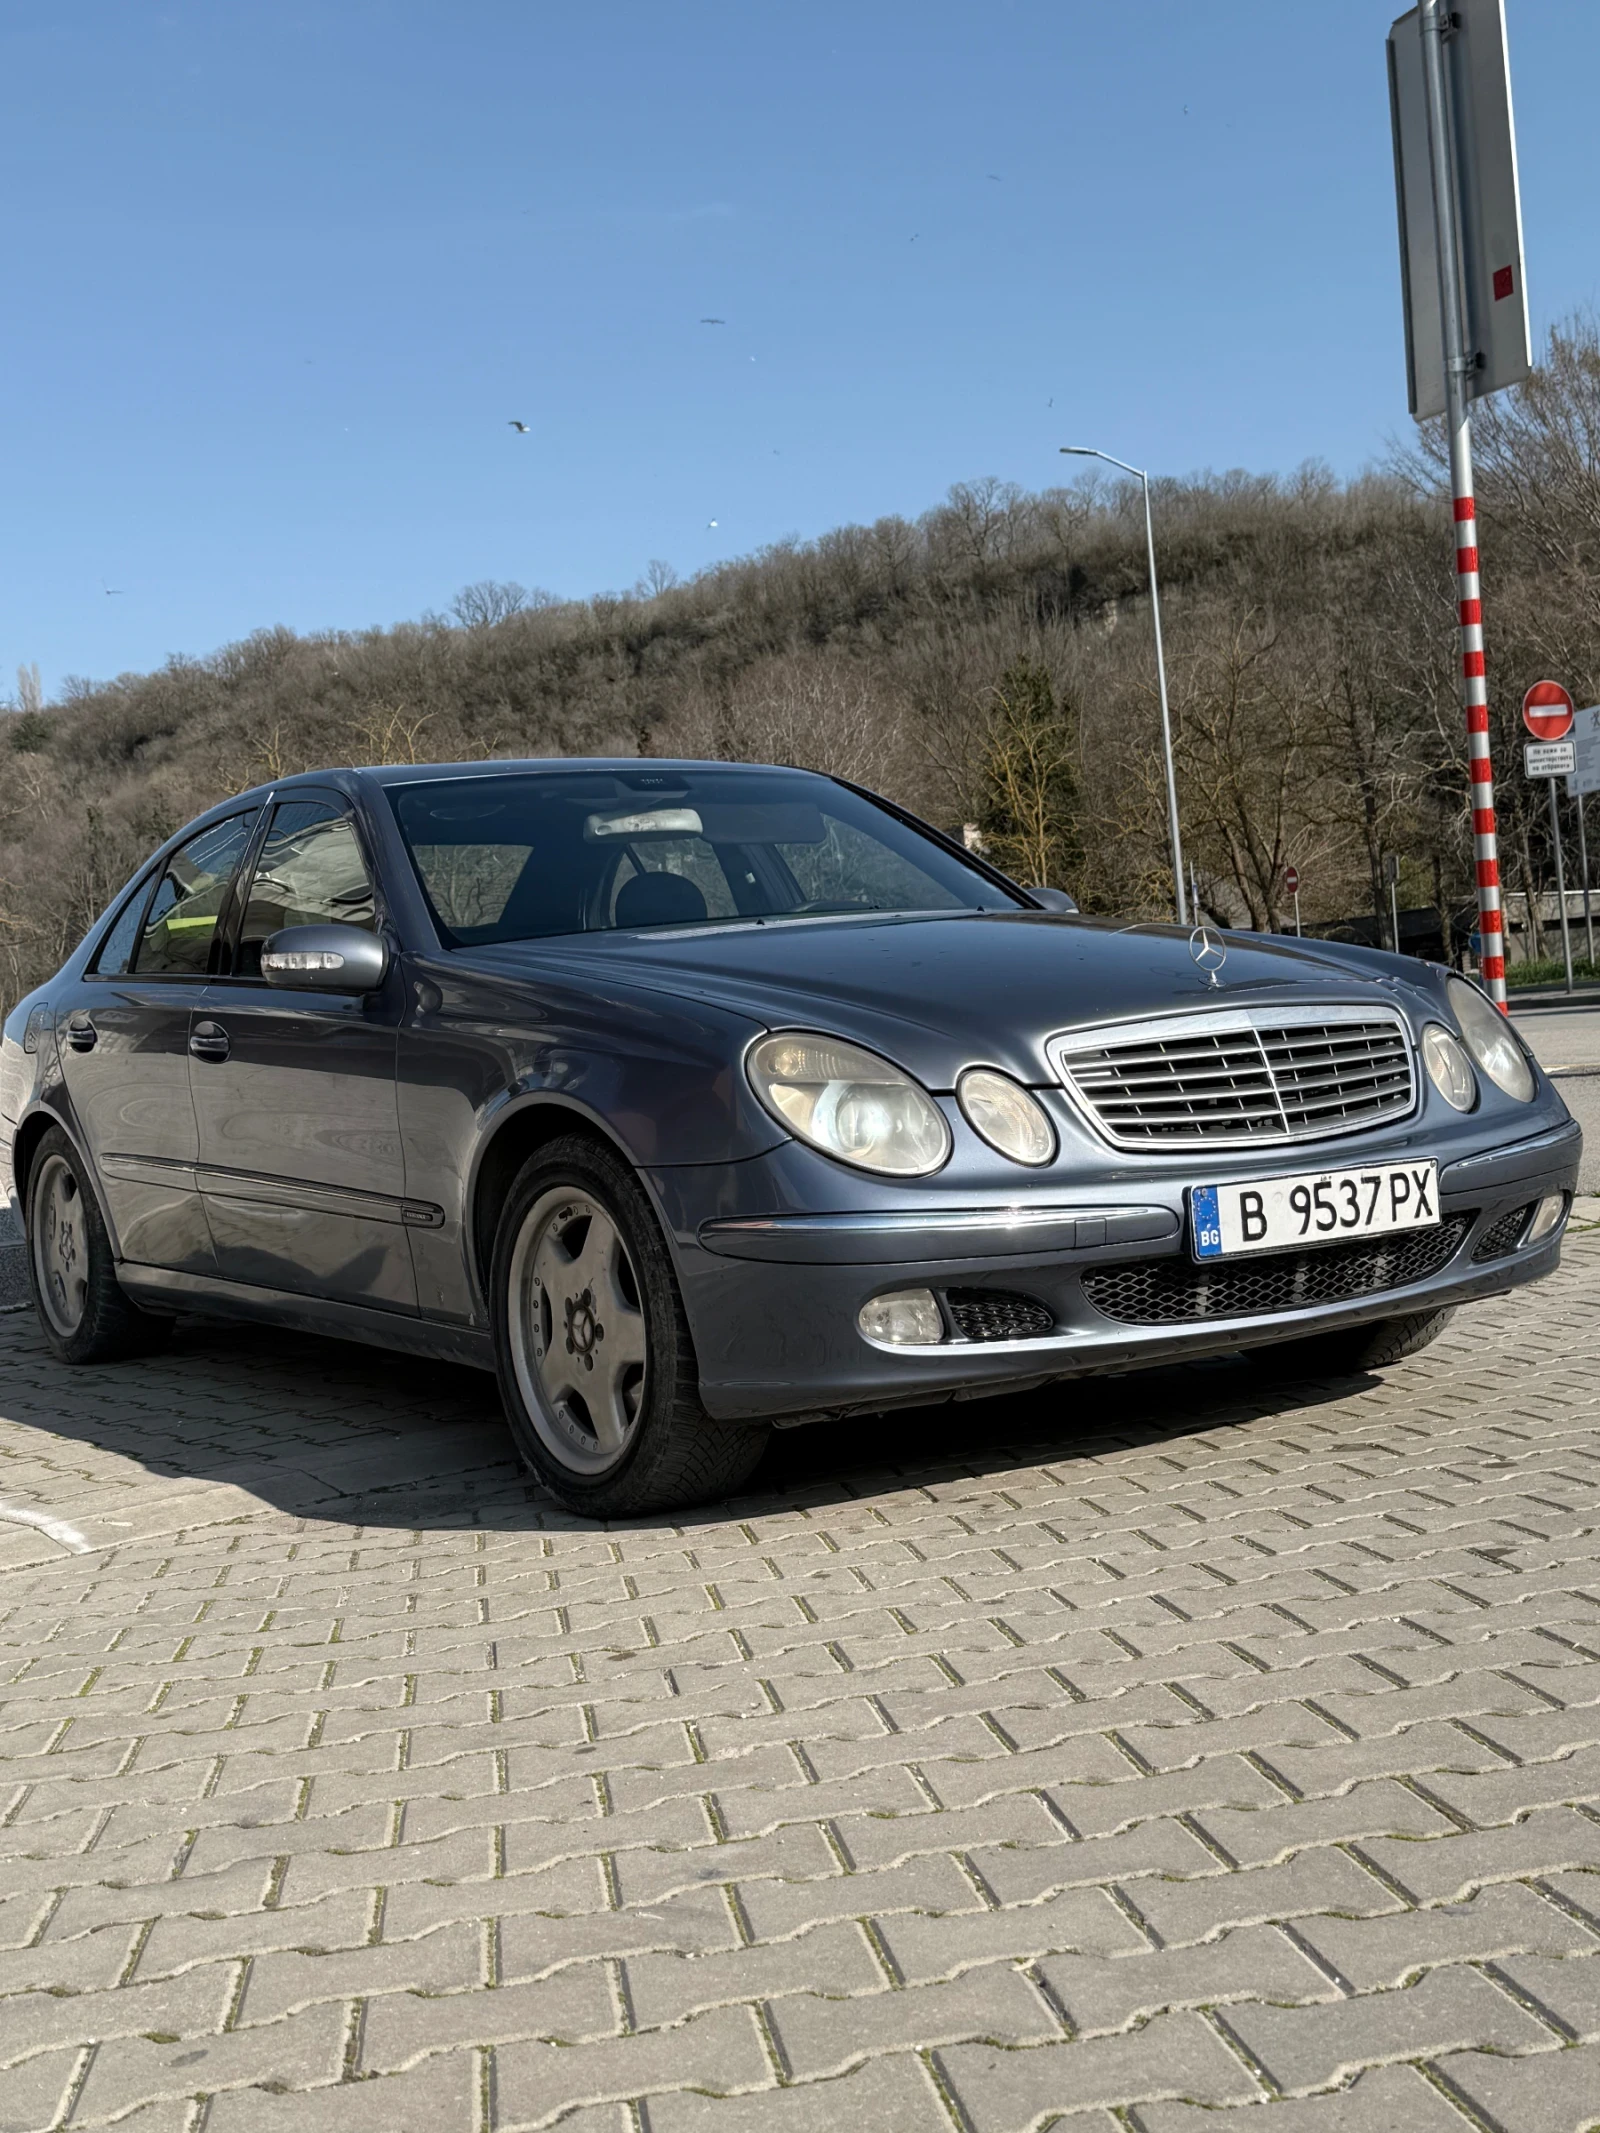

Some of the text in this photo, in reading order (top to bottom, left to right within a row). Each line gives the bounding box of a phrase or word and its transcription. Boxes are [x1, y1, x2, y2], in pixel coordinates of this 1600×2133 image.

[1239, 1168, 1433, 1242] B 9537 PX
[1200, 1230, 1220, 1247] BG
